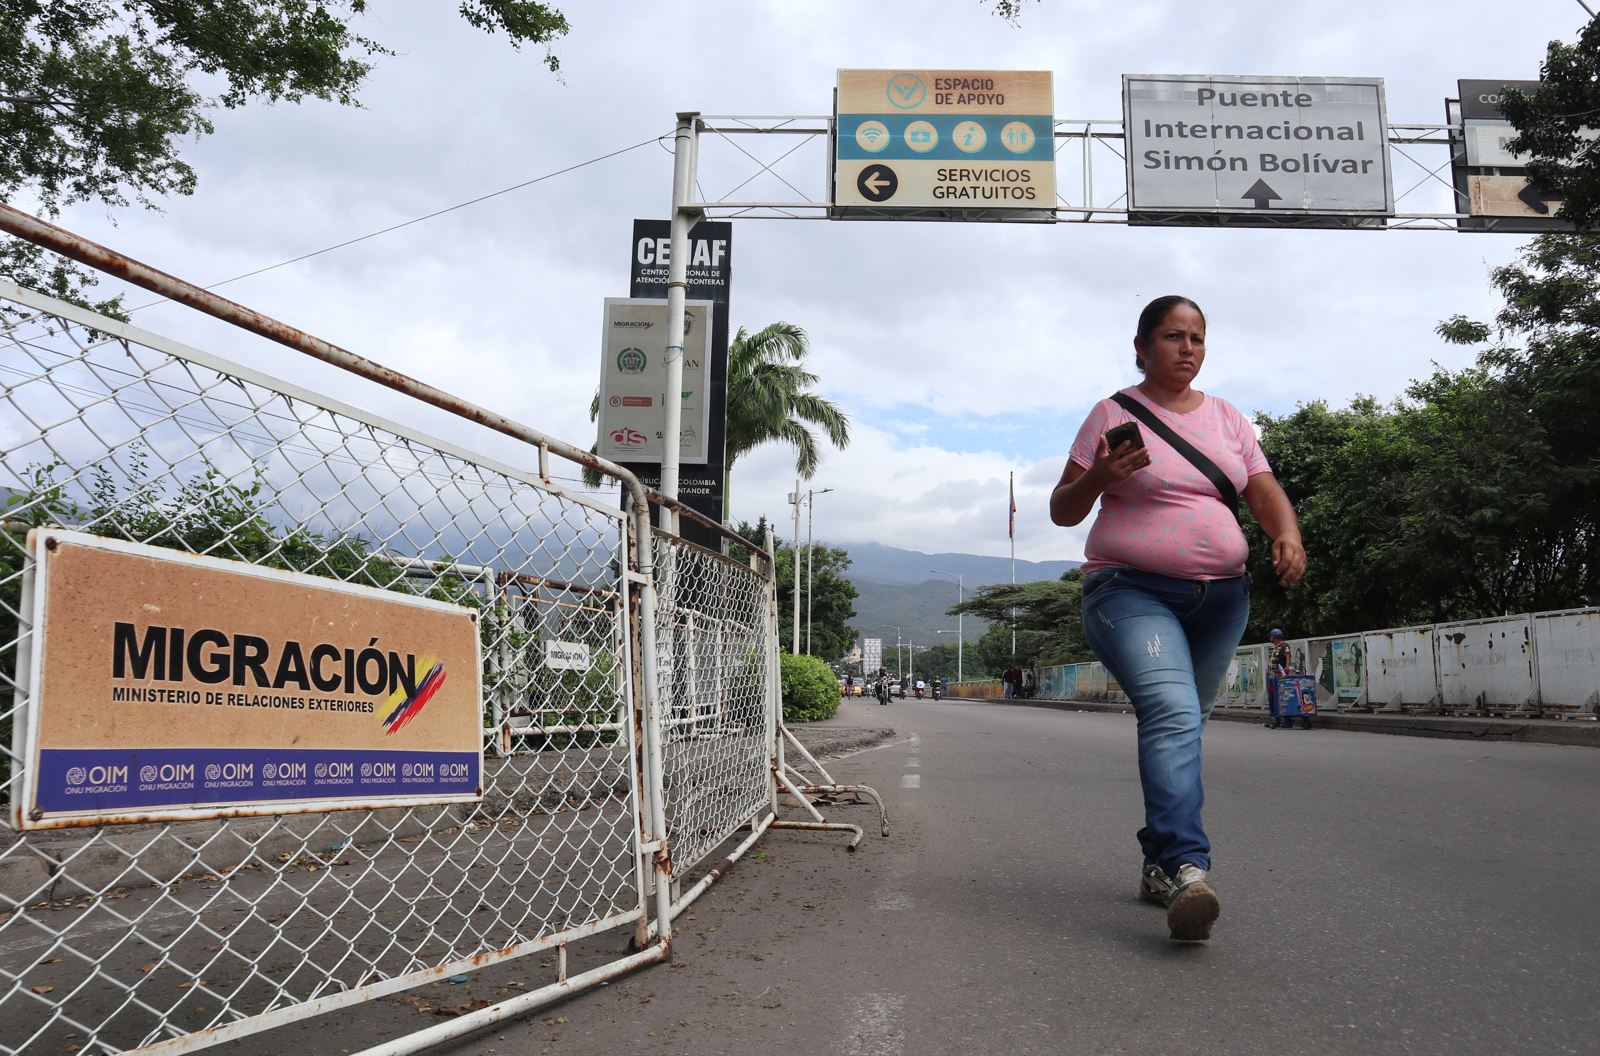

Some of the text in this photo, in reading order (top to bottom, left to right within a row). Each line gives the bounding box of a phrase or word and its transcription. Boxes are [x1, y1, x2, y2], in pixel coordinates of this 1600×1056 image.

[935, 78, 994, 91] ESPACIO
[935, 93, 1005, 106] DE APOYO
[1197, 88, 1312, 107] Puente
[1144, 119, 1364, 141] Internacional
[1143, 150, 1374, 174] Simón Bolívar
[937, 168, 1031, 182] SERVICIOS
[932, 186, 1036, 200] GRATUITOS
[641, 268, 669, 276] CENTRO
[678, 486, 710, 495] NTANDER
[112, 620, 417, 699] MIGRACIÓN
[113, 687, 374, 713] MINISTERIO DE RELACIONES EXTERIORES
[89, 765, 129, 784] OIM
[160, 764, 194, 782] OIM
[223, 763, 254, 780] OIM
[278, 763, 306, 779] OIM
[328, 762, 354, 777] OIM
[373, 762, 396, 777] OIM
[413, 763, 434, 776] OIM
[449, 763, 469, 776] OIM
[65, 784, 127, 795] ONU MIGRACIÓN
[156, 782, 194, 791] MIGRACIÓN
[204, 780, 254, 789] ONU MIGRACIÓN
